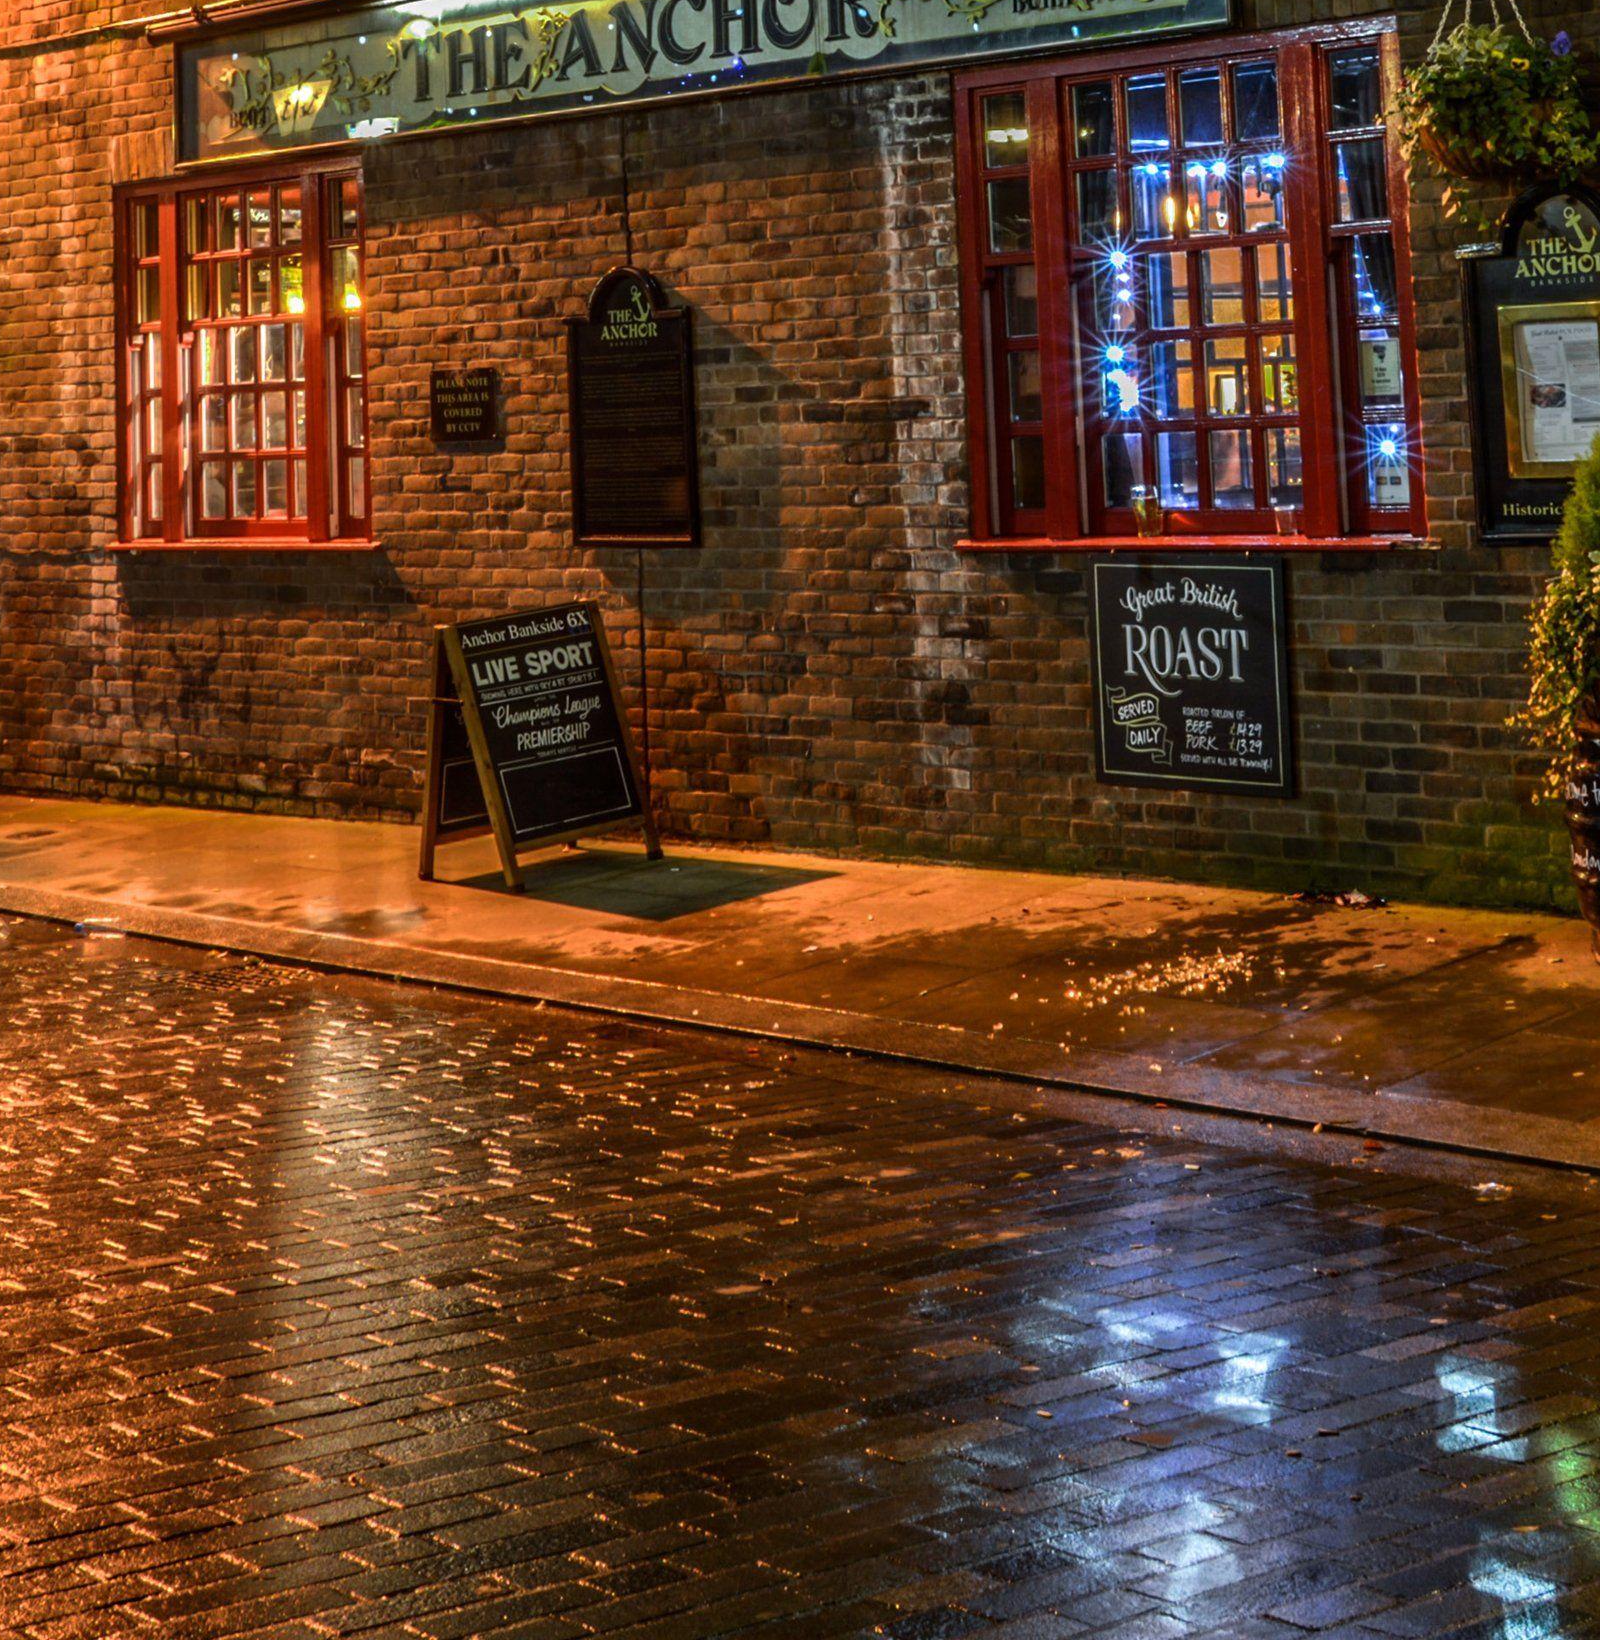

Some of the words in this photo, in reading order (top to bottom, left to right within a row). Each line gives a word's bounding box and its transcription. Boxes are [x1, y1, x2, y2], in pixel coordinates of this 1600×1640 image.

[401, 15, 532, 103] THE
[1526, 236, 1567, 256] THE
[607, 308, 632, 324] THE
[601, 321, 658, 341] ANCHOR
[466, 377, 489, 388] NOTE
[436, 393, 456, 403] THIS
[457, 392, 479, 402] AREA
[481, 391, 489, 401] IS
[443, 406, 482, 418] COVERED
[446, 423, 457, 433] BY
[458, 422, 480, 433] CCTV
[1503, 502, 1563, 516] Historic
[1119, 581, 1176, 622] Great
[1179, 577, 1244, 622] British
[461, 629, 506, 650] Anchor
[507, 616, 565, 641] Bankside
[566, 610, 589, 629] 6X
[471, 656, 521, 688] LIVE
[524, 641, 593, 677] SPORT
[1121, 623, 1250, 698] ROAST
[491, 703, 561, 729] Champions
[565, 694, 601, 720] League
[1117, 699, 1155, 721] SERVED
[517, 721, 591, 752] PREMIERSHIP
[1129, 726, 1162, 747] DAILY
[1185, 719, 1214, 734] BEEF
[1185, 734, 1220, 751] PORK
